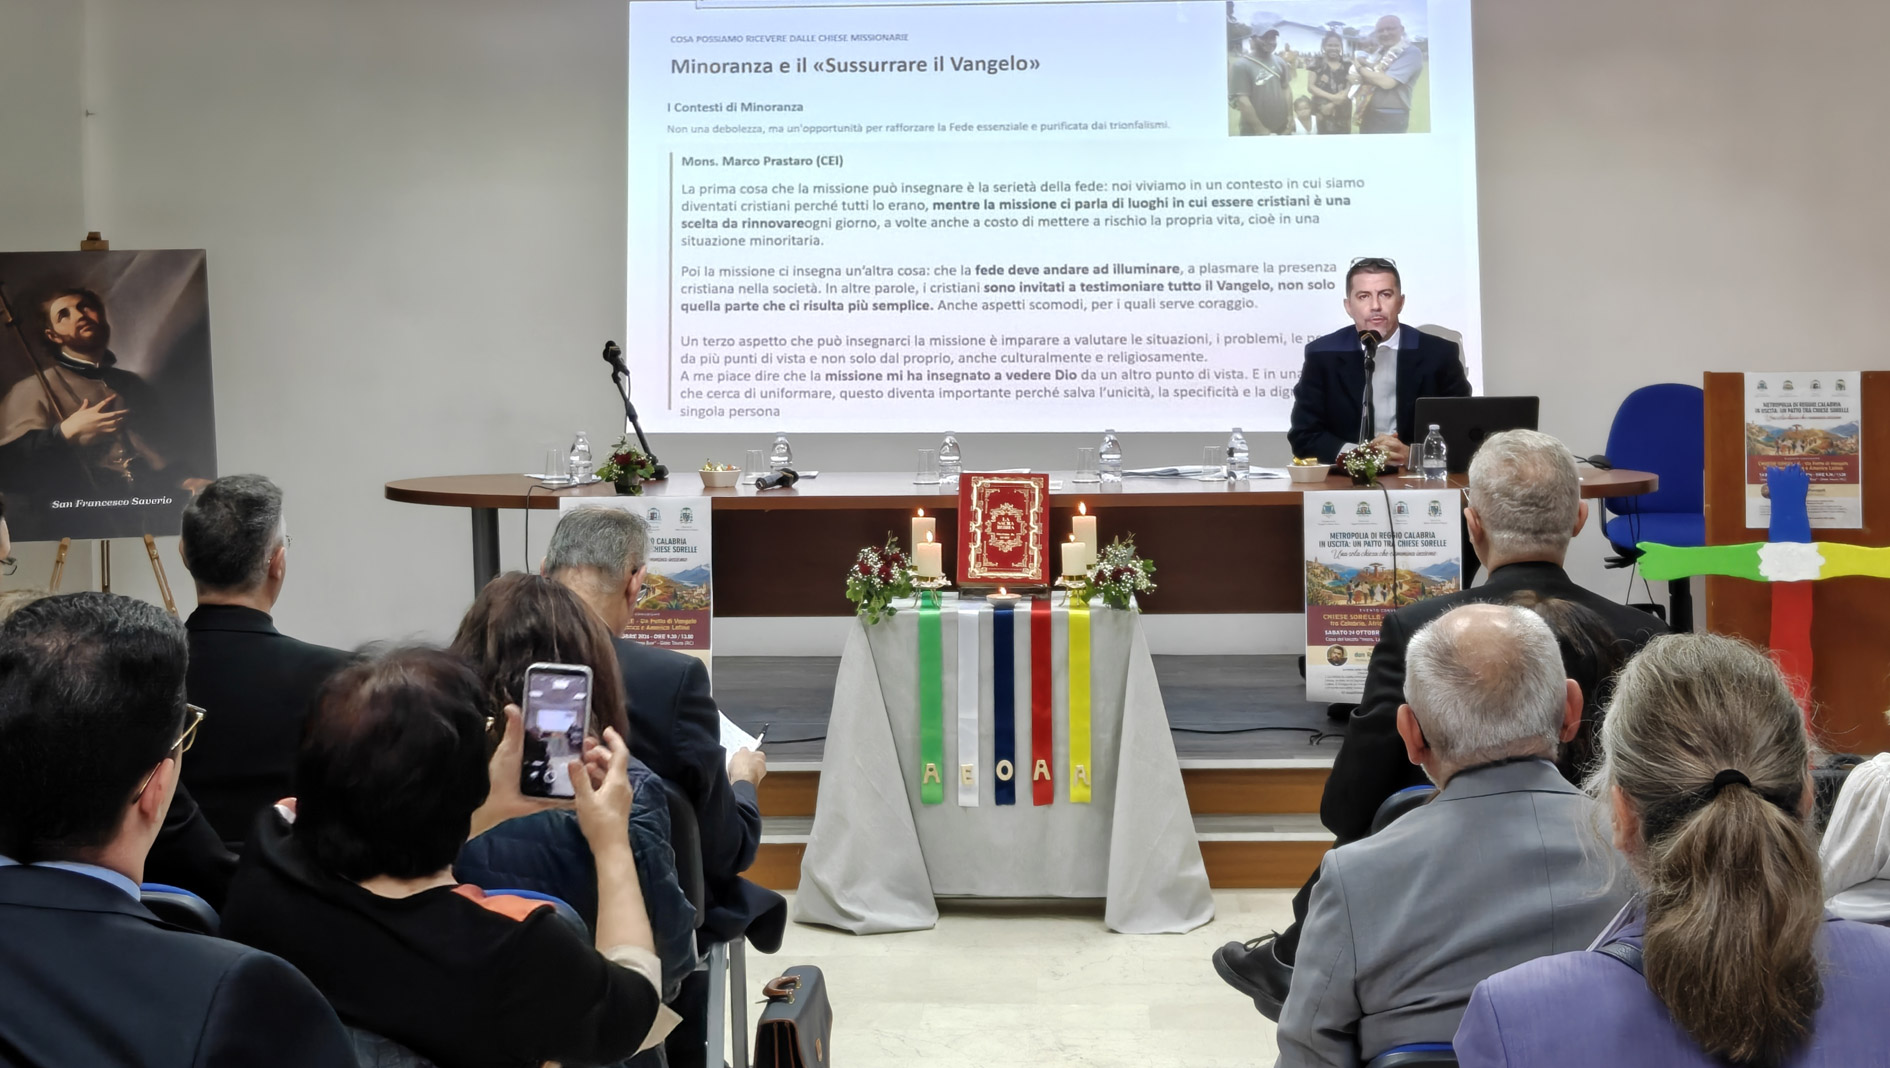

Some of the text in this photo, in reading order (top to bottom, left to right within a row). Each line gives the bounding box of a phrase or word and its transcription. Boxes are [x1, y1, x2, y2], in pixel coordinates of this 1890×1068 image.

[670, 33, 908, 43] COSA POSSIAMO RICEVERE DALLE CHIESE MISSIONARIE
[671, 54, 1040, 75] Minoranza e il «Sussurrare il Vangelo»
[667, 101, 803, 112] I Contesti di Minoranza
[667, 124, 688, 134] Non
[712, 124, 766, 135] debolezza,
[866, 126, 882, 134] per
[886, 122, 935, 132] rafforzare
[938, 122, 947, 132] la
[950, 122, 974, 132] Fede
[977, 122, 1029, 131] essenziale
[1040, 121, 1088, 132] purificata
[1091, 121, 1107, 130] dai
[1110, 120, 1170, 130] trionfalismi.
[681, 154, 843, 168] Mons. Marco Prastaro (CEI)
[682, 177, 1364, 196] La prima cosa che la missione può insegnare è la serietà della fede: noi viviamo in un contesto in cui siamo
[680, 297, 1257, 313] quella parte che ci risulta più semplice. Anche aspetti scomodi, per i quali serve coraggio.
[680, 351, 1207, 366] da più punti di vista e non solo dal proprio, anche culturalmente e religiosamente.
[680, 405, 780, 419] singola persona
[52, 496, 172, 508] San Francesco Saverio
[1330, 532, 1368, 540] METROPOLIA
[923, 760, 1090, 787] A E O A A
